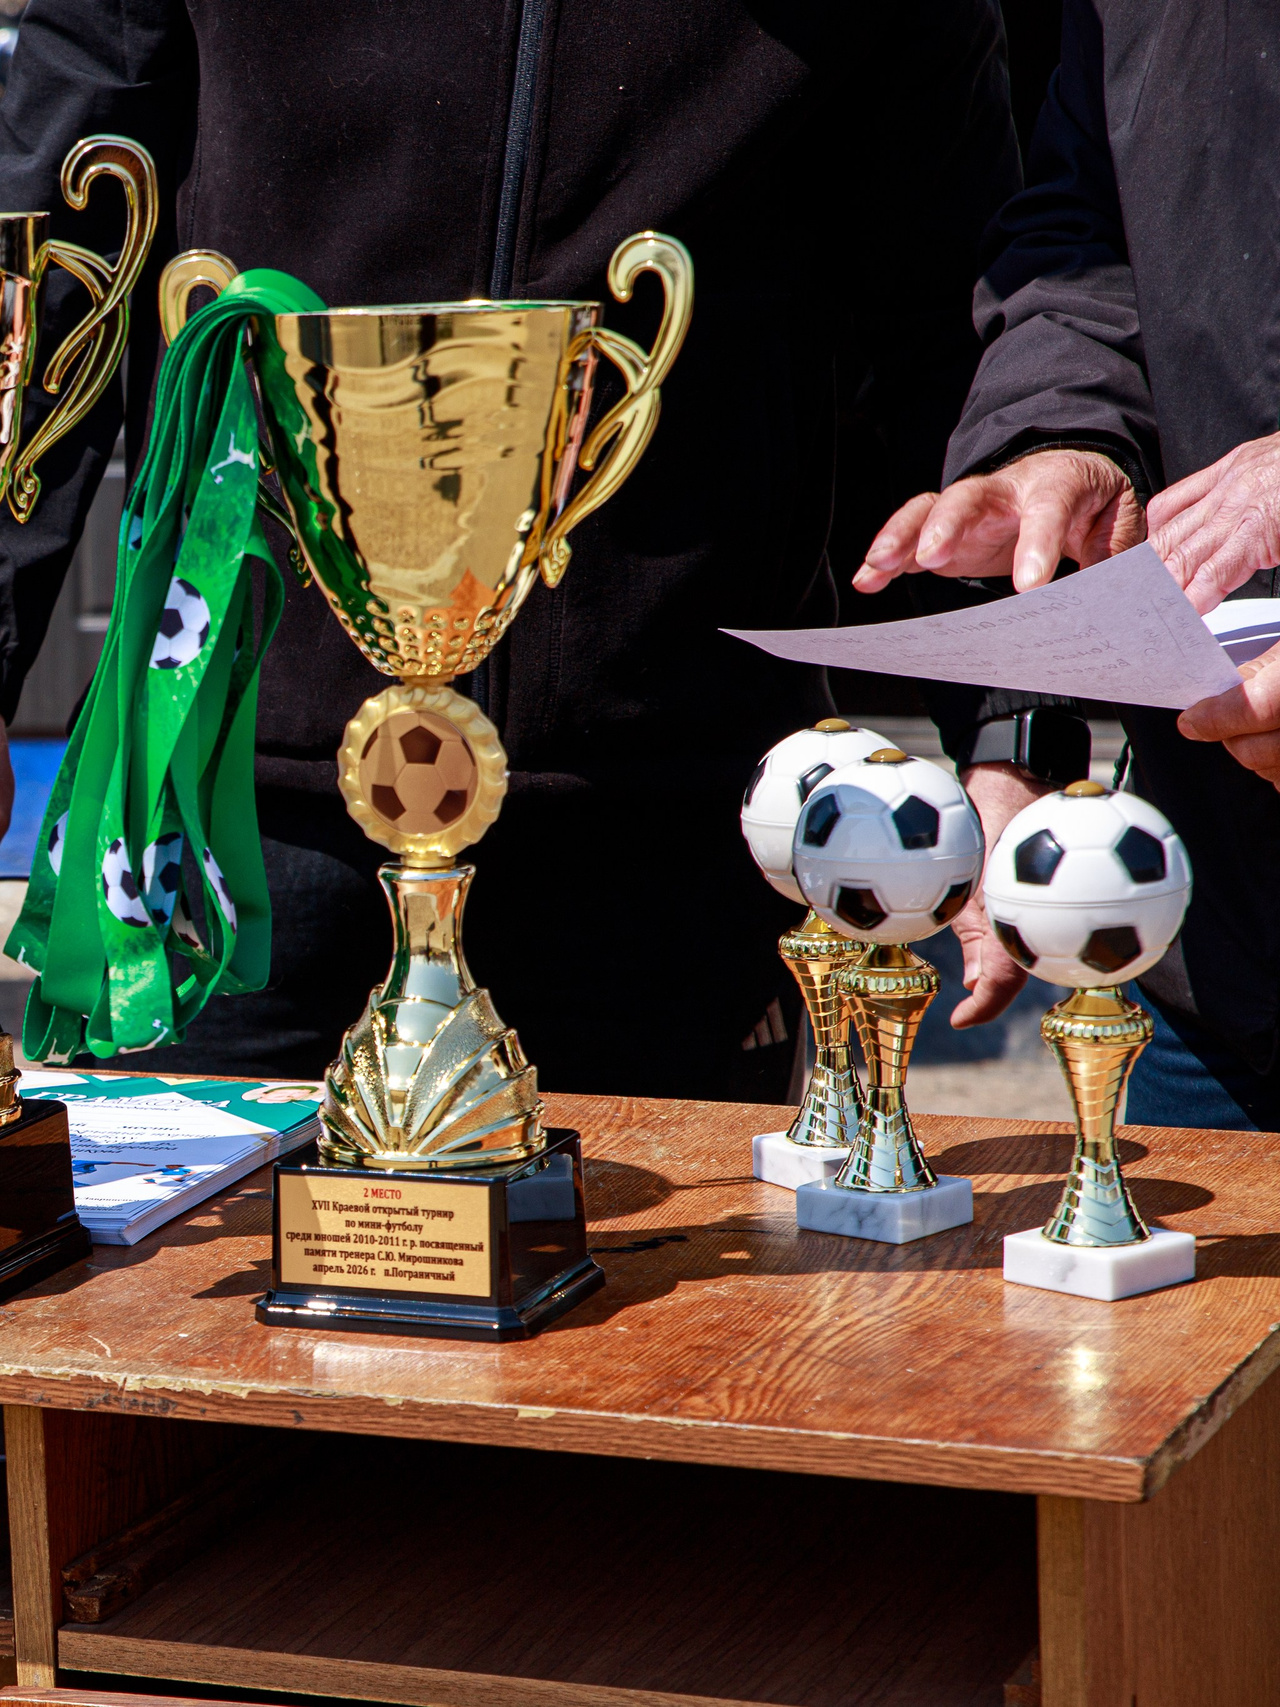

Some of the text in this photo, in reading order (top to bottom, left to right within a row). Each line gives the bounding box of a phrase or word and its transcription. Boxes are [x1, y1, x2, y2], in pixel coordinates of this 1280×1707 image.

[364, 1188, 401, 1199] 2 МЕСТО
[312, 1200, 454, 1221] XVII Краевой открытый турнир
[345, 1219, 423, 1234] по мини-футболу
[286, 1232, 483, 1252] среди юношей 2010-2011 г. р. посвященный
[304, 1248, 464, 1266] памяти тренера С.Ю. Мирошникова
[313, 1264, 344, 1275] апрель
[347, 1265, 368, 1275] 2026
[384, 1268, 455, 1281] п.Пограничный
